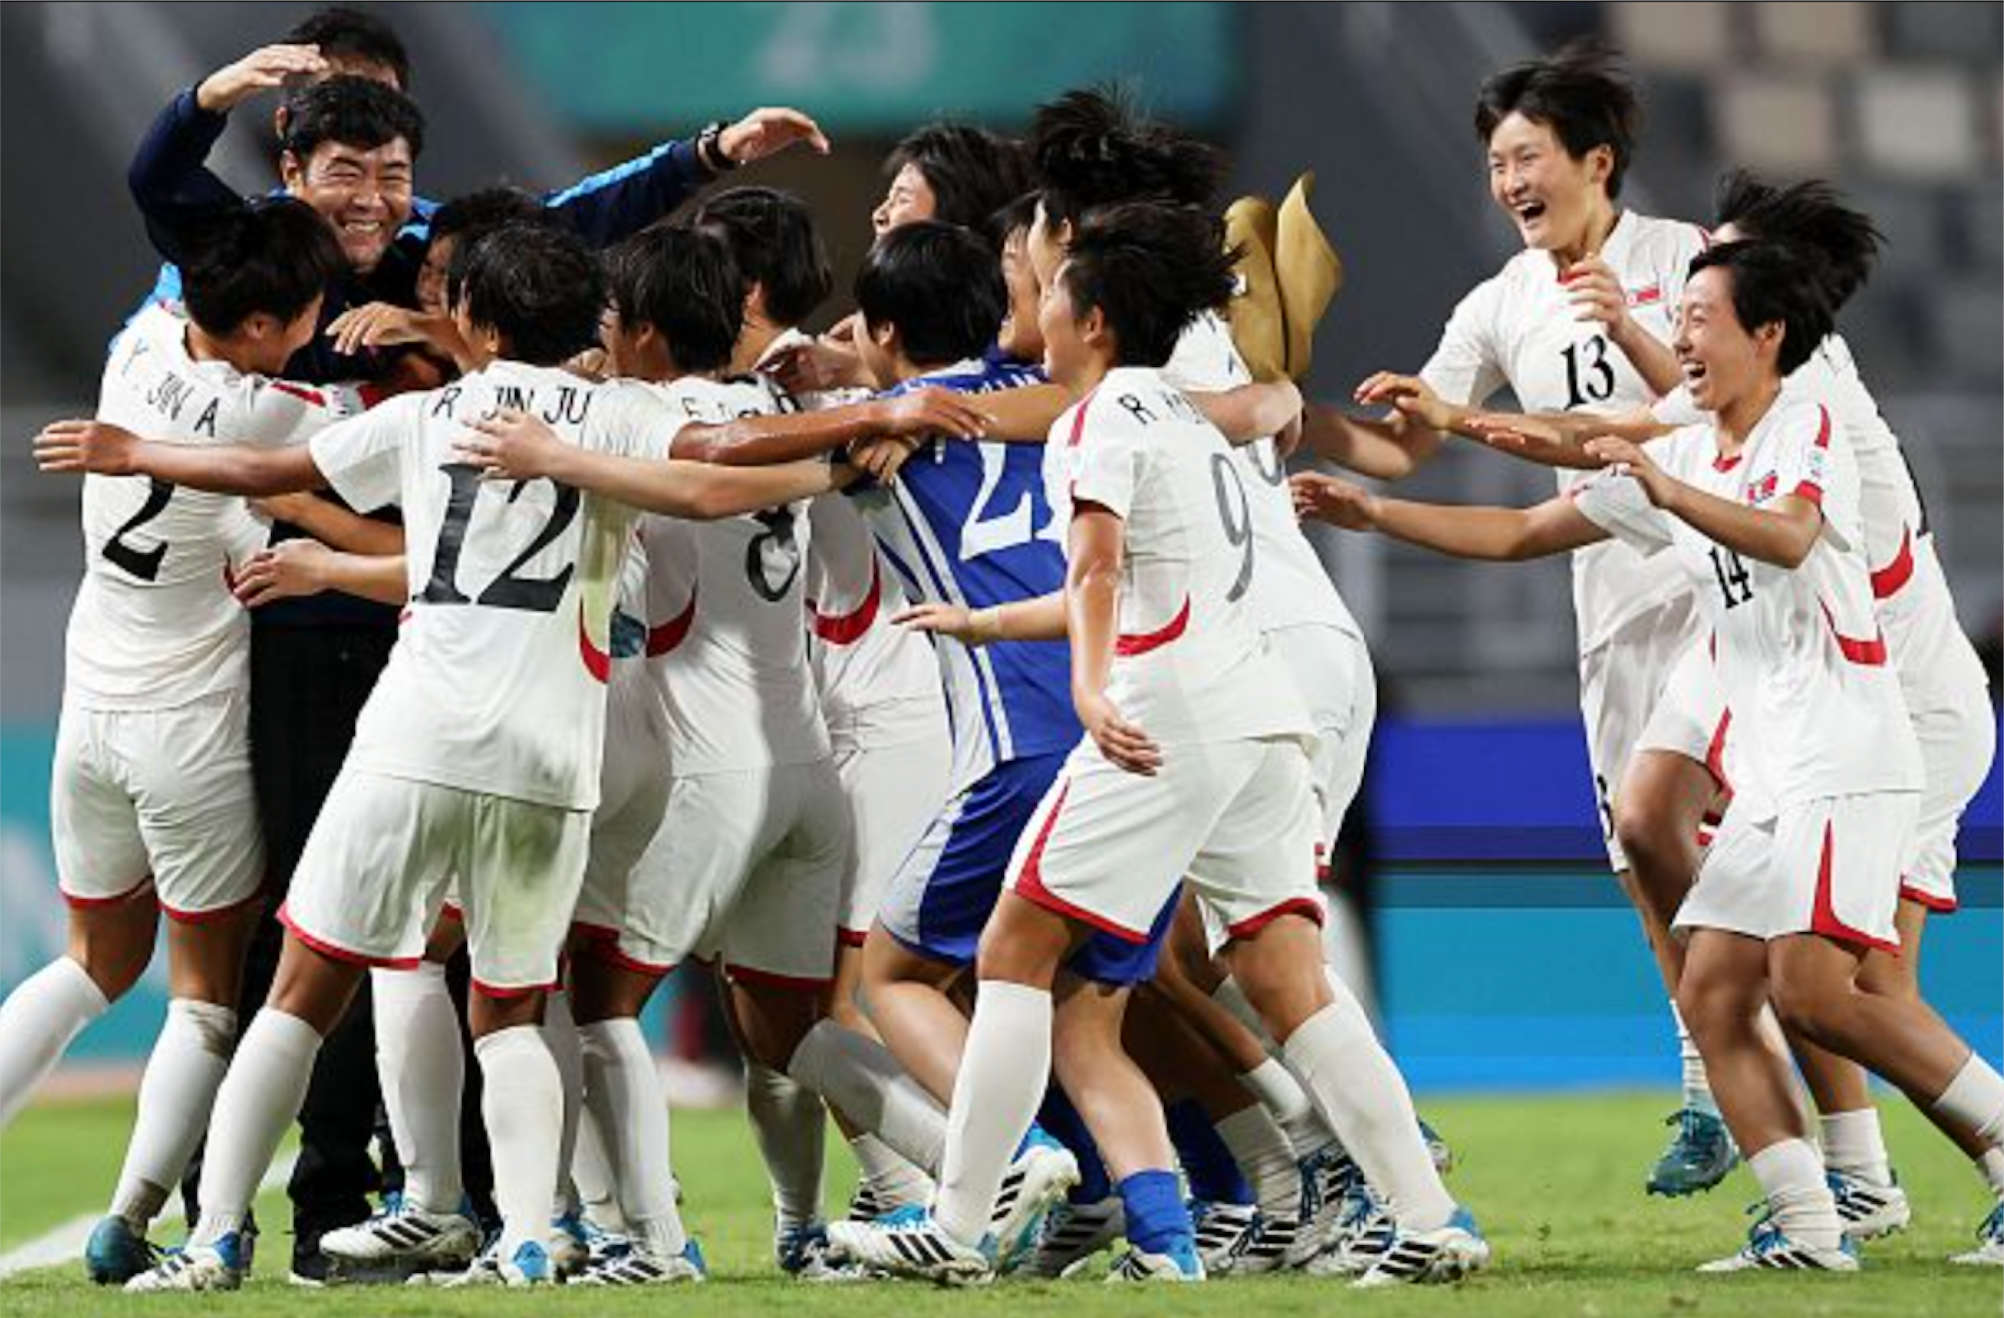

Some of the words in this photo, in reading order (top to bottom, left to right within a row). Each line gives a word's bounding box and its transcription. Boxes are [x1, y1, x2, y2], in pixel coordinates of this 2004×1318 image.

[432, 387, 462, 417] R
[543, 385, 592, 424] JU
[1560, 334, 1614, 411] 13
[194, 397, 219, 437] A
[1117, 393, 1157, 425] R
[102, 476, 176, 581] 2
[412, 463, 580, 612] 12
[1210, 453, 1253, 602] 9
[1708, 547, 1753, 609] 14
